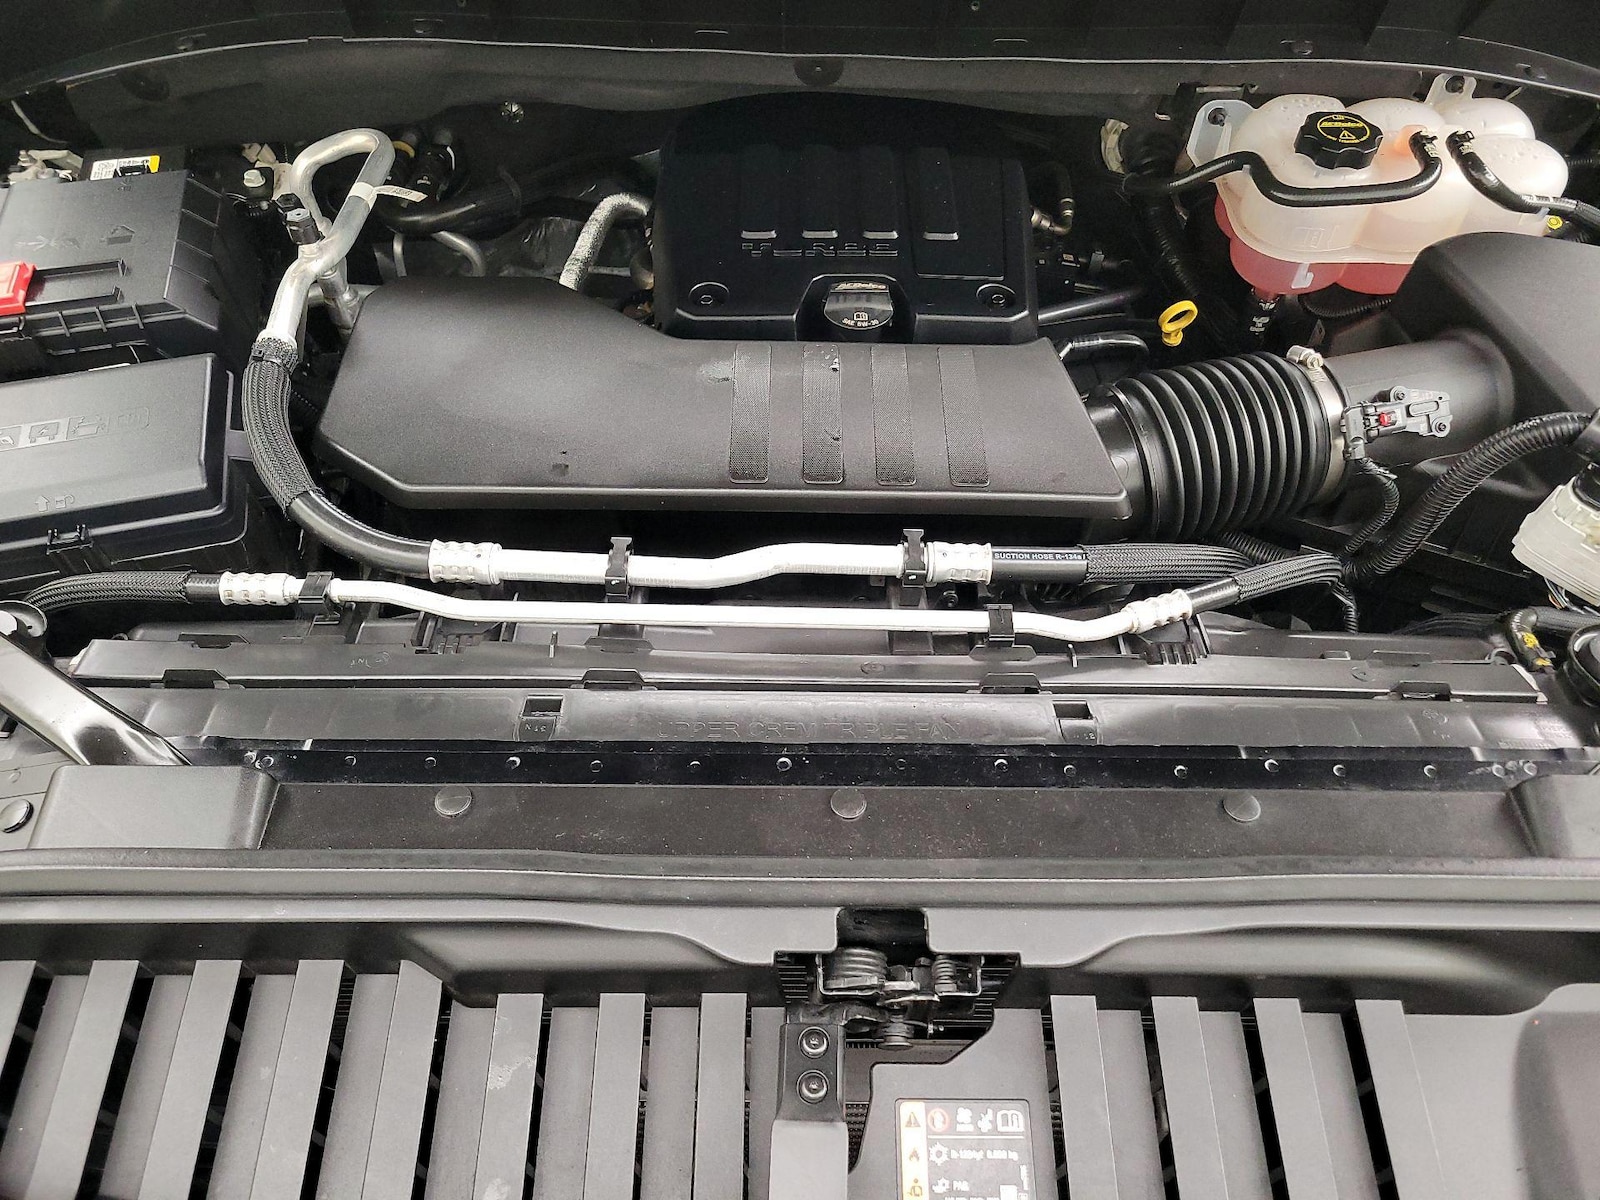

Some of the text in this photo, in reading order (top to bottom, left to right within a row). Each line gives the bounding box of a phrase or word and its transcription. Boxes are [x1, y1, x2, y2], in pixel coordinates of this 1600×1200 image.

[994, 552, 1030, 560] SUCTION
[657, 721, 740, 738] UPPER
[824, 722, 907, 740] TRIPLE
[916, 722, 961, 740] FAN
